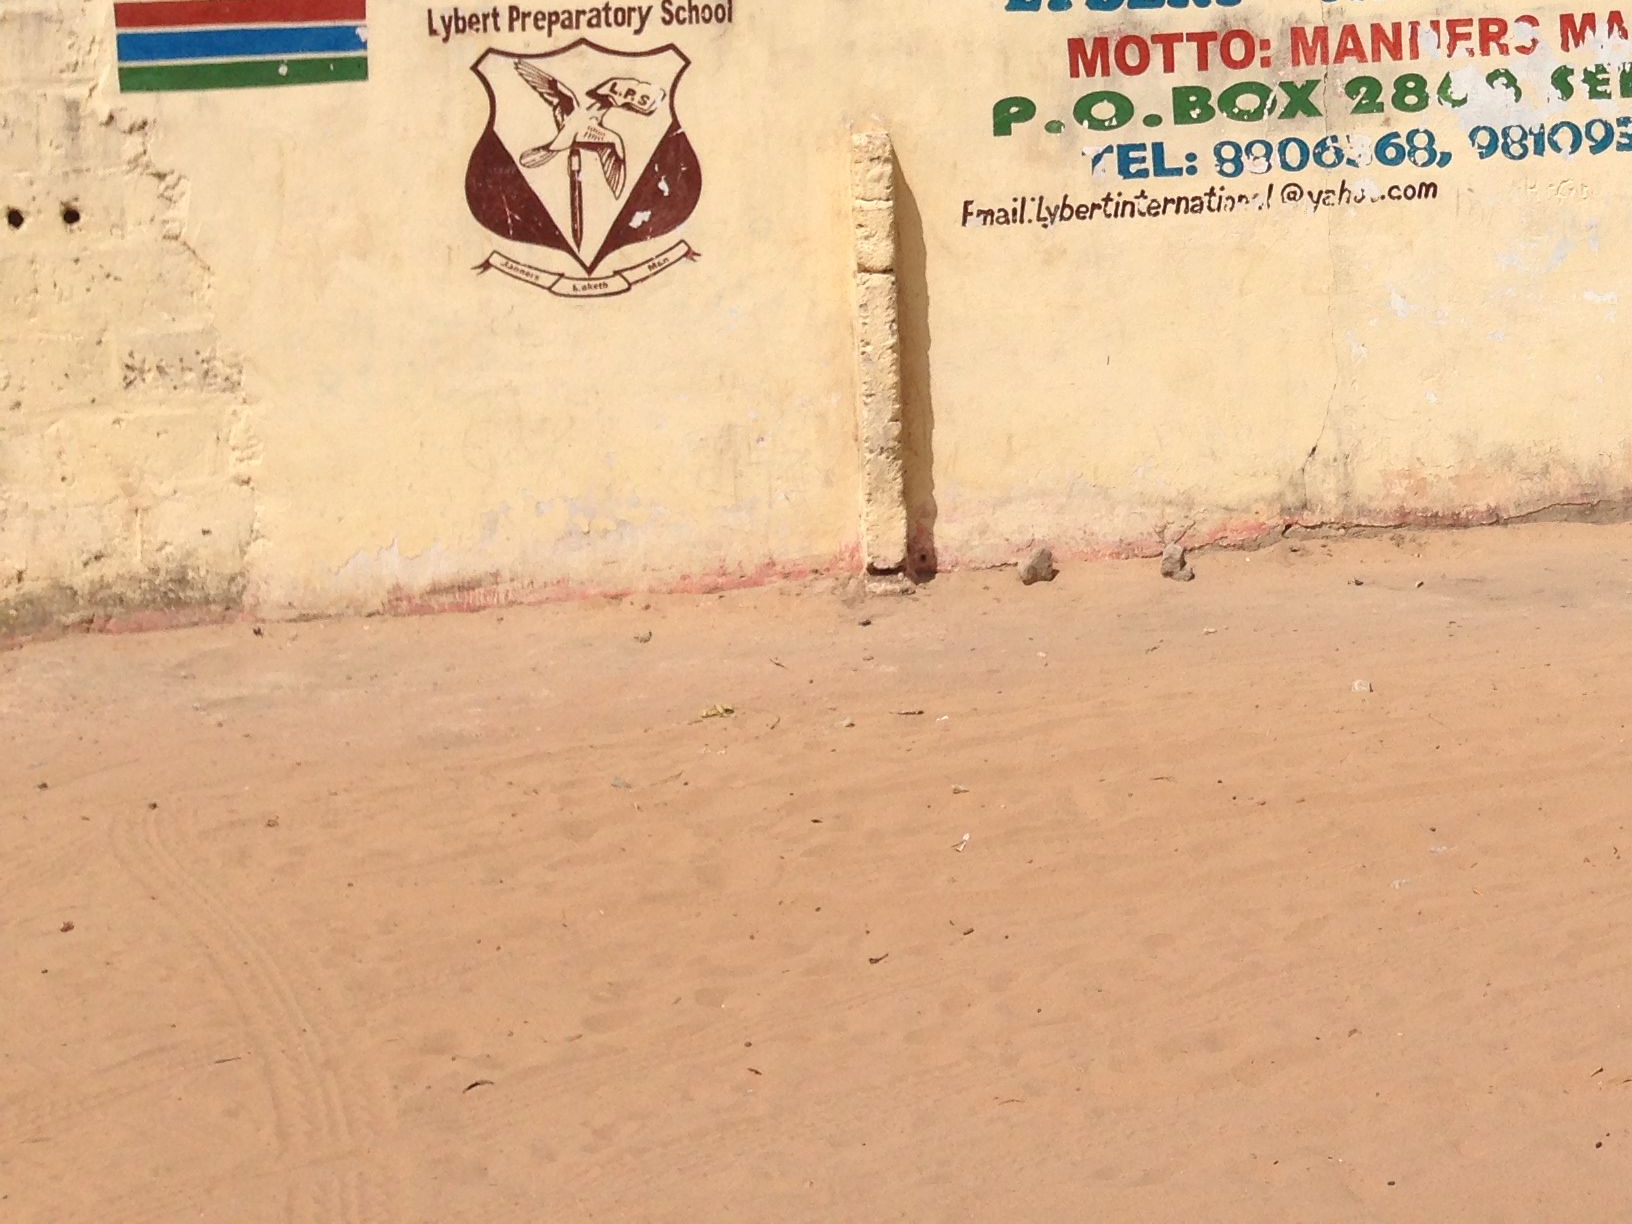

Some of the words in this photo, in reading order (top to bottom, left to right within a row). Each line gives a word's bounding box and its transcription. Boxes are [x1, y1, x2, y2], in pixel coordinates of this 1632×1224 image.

[427, 7, 501, 43] Lybert
[508, 1, 653, 38] Preparatory
[1067, 29, 1272, 78] MOTTO:
